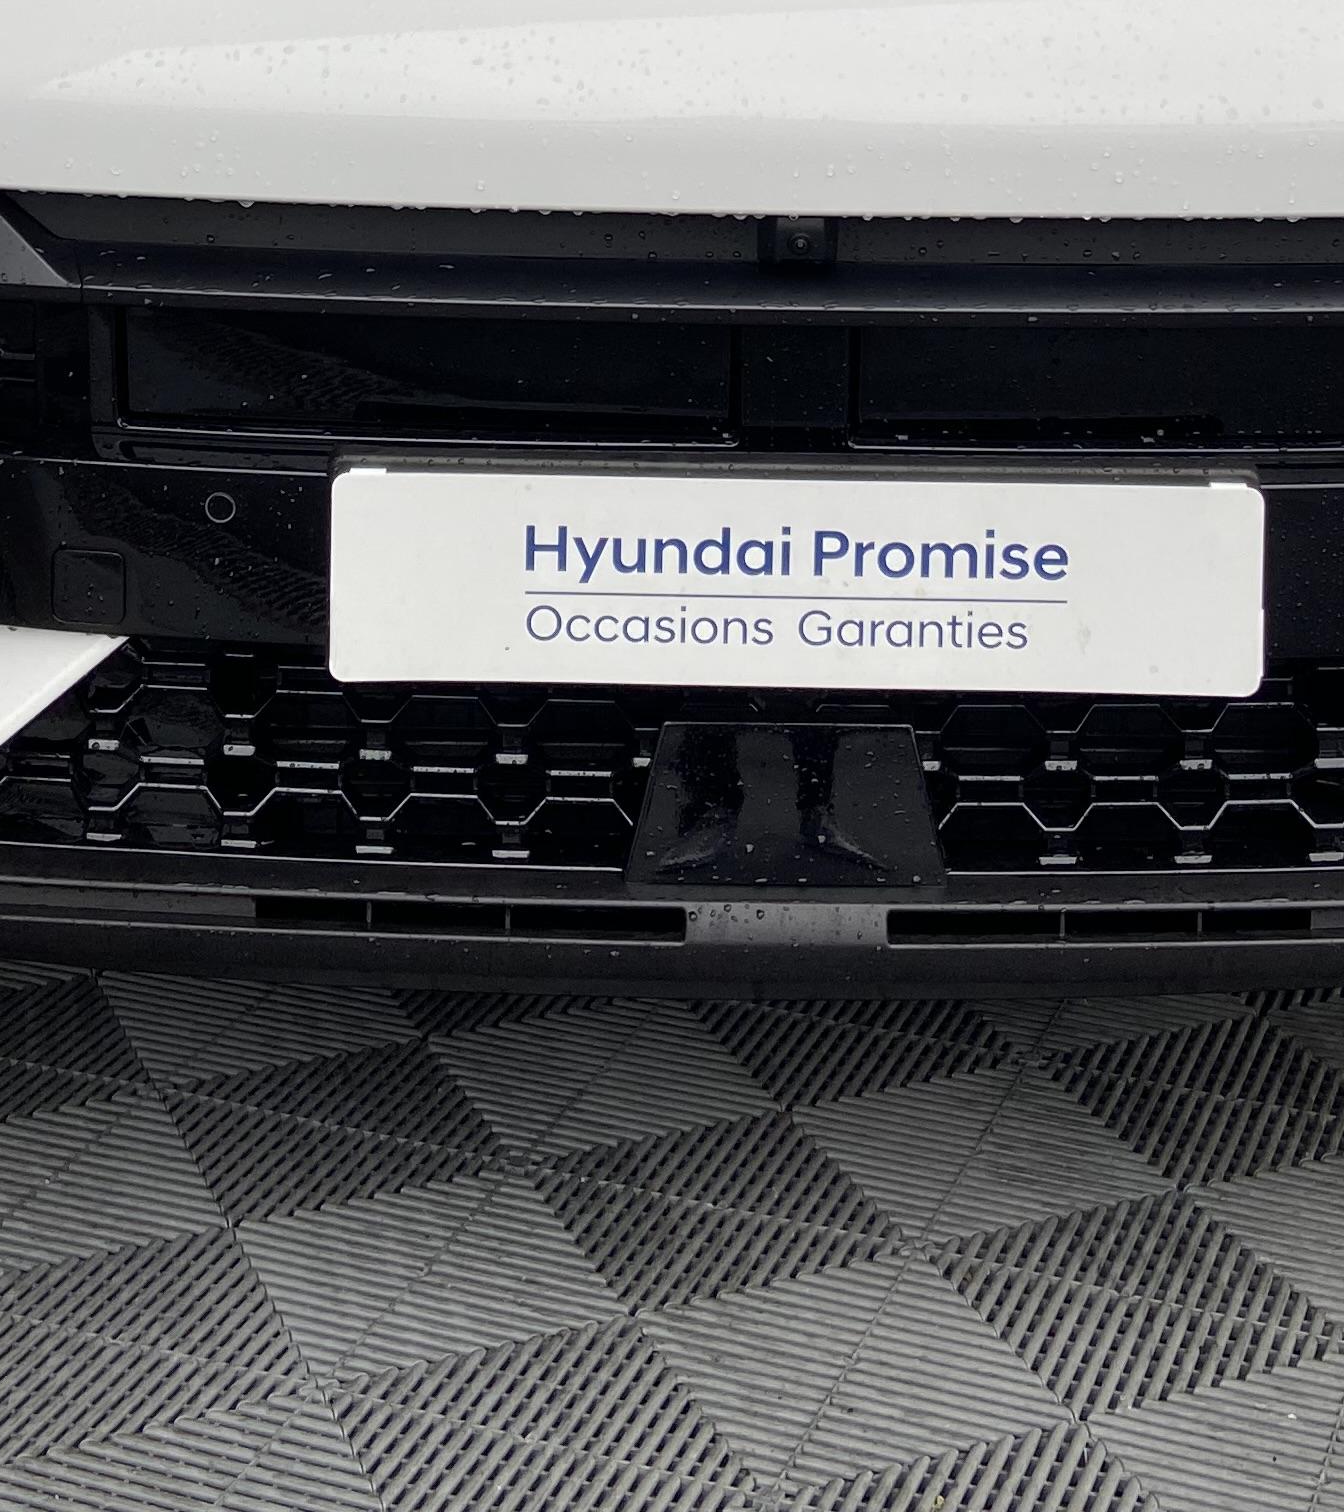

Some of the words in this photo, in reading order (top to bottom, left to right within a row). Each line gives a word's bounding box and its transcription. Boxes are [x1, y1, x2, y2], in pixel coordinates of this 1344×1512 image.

[525, 525, 792, 583] Hyundai
[813, 528, 1069, 581] Promise
[526, 605, 774, 645] Occasions
[798, 609, 1028, 650] Garanties
